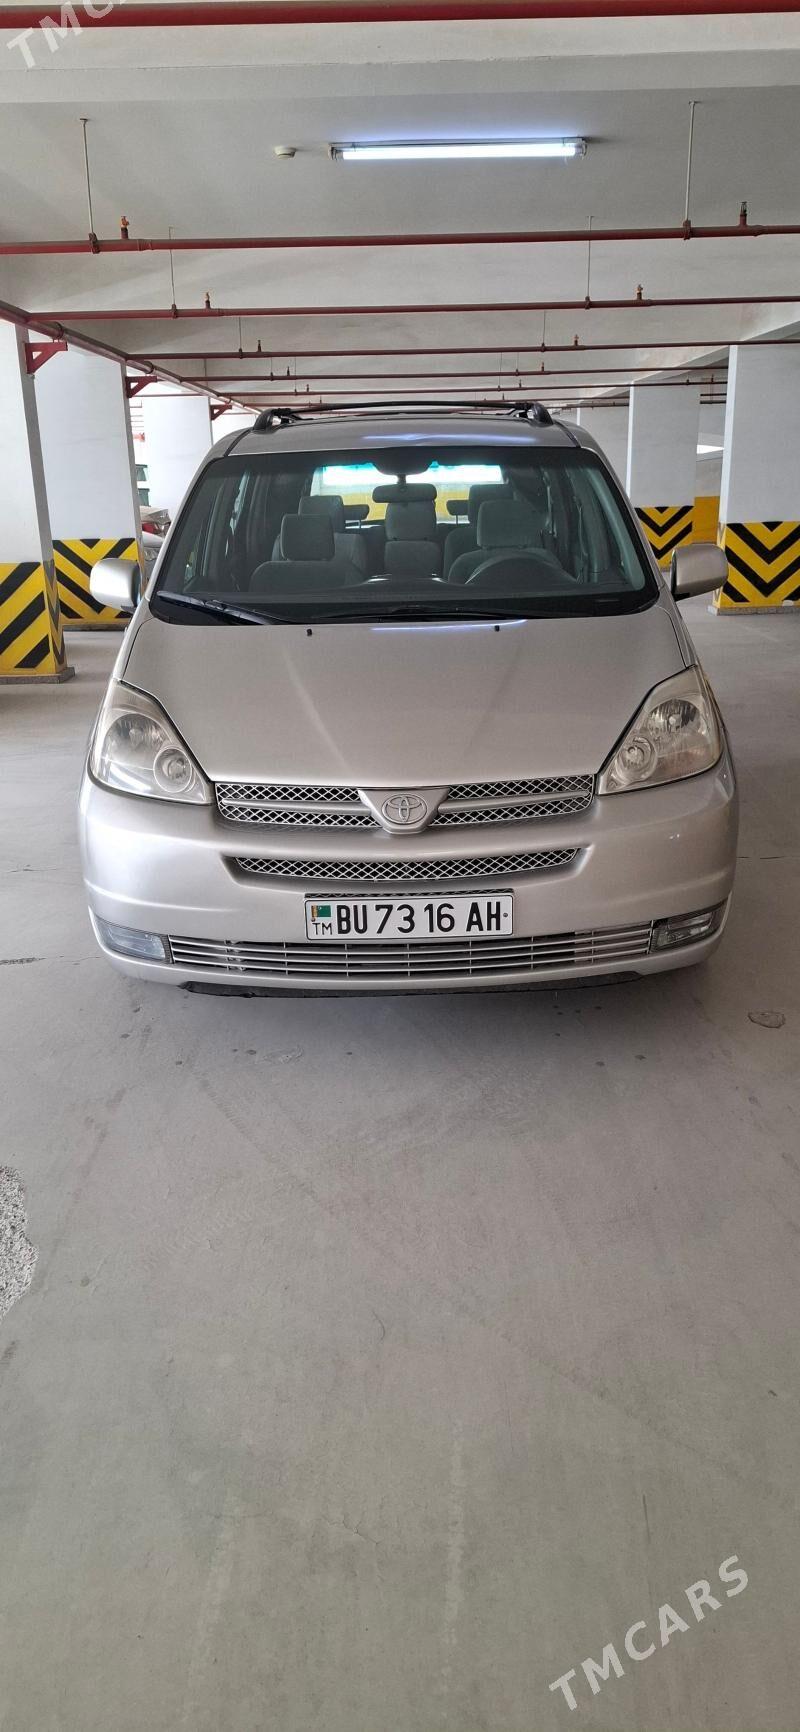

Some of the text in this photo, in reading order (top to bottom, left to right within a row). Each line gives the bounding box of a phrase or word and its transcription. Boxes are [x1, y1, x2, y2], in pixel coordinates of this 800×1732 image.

[312, 922, 332, 935] TM
[337, 901, 501, 935] BU 73 16 AH
